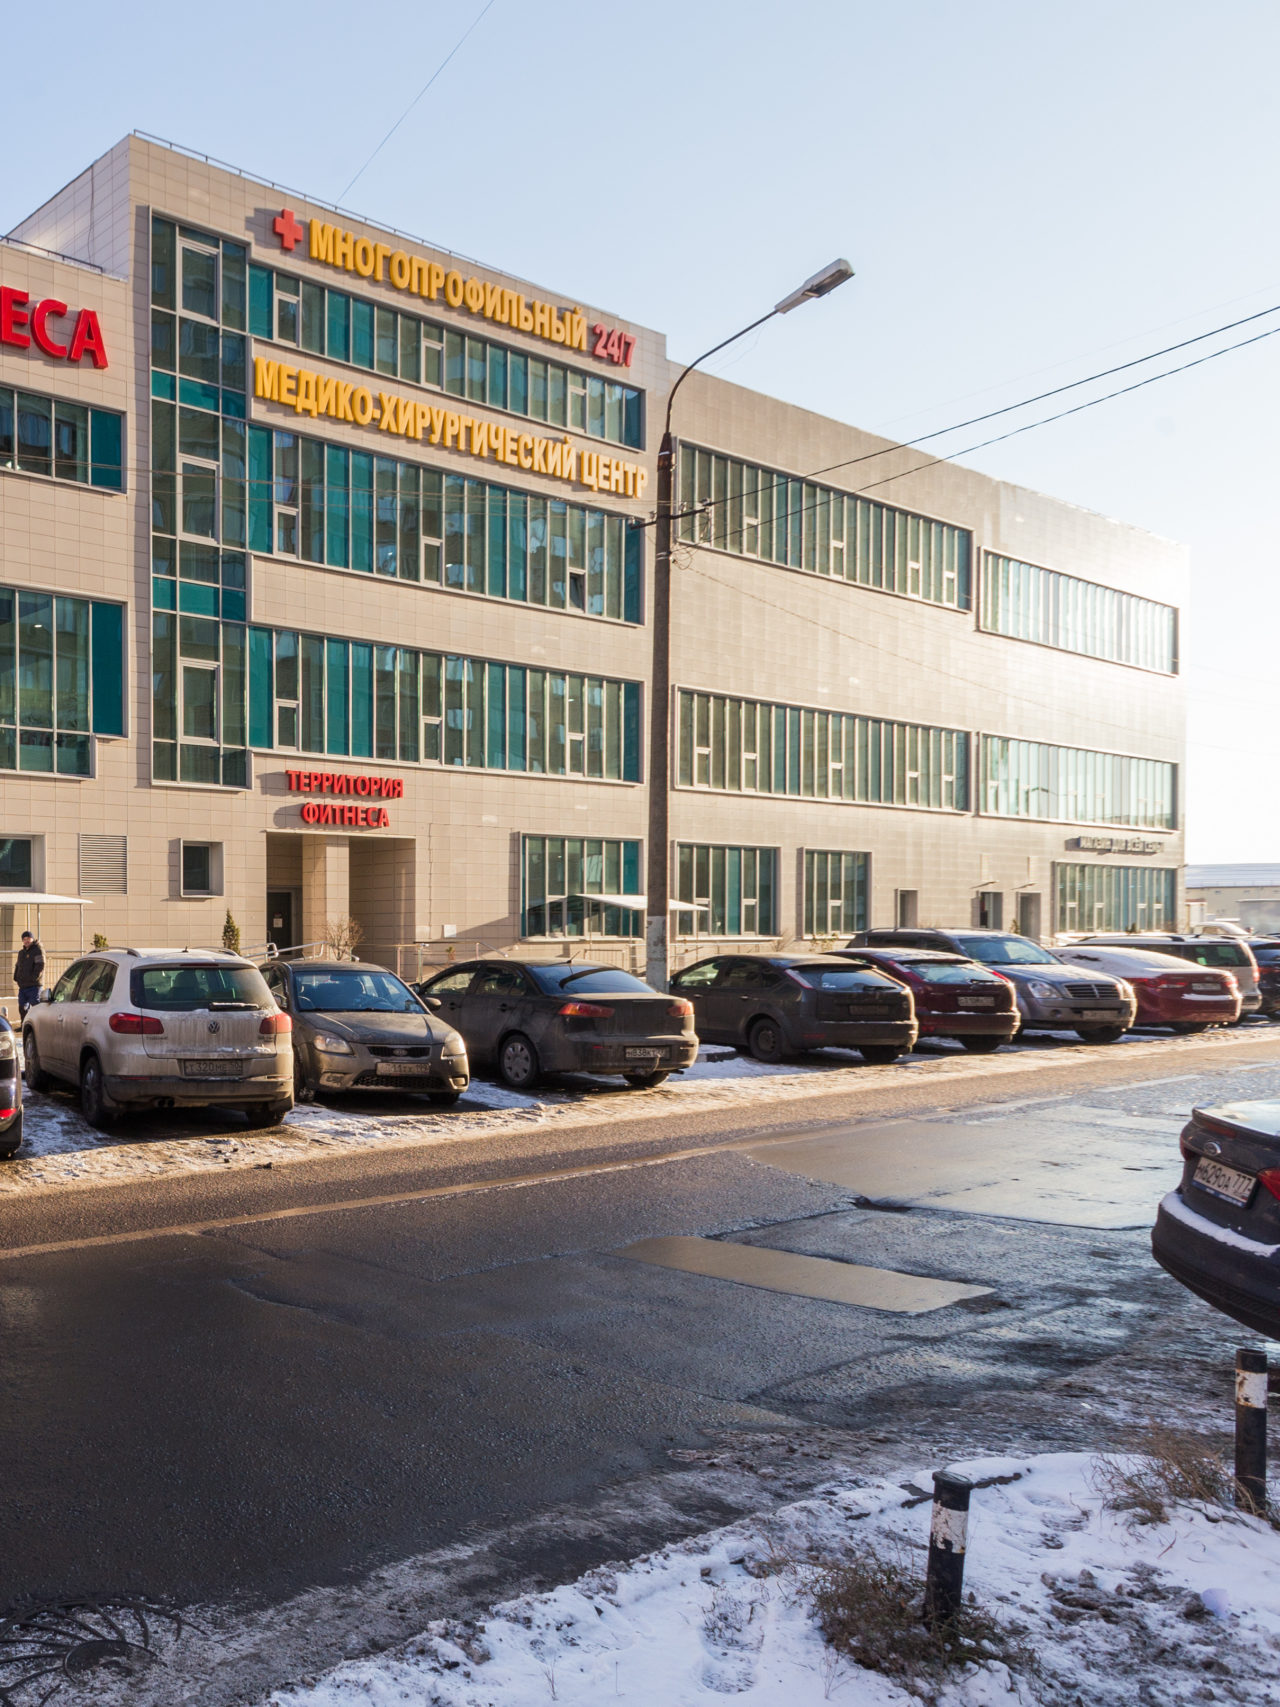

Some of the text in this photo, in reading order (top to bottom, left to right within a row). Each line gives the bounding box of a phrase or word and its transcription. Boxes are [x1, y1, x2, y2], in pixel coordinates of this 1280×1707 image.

[309, 218, 636, 368] МНОГОПРОФИЛЬНЫЙ 24/7
[254, 356, 649, 499] МЕДИКО-ХИРУРГИЧЕСКИЙ ЦЕНТР
[285, 769, 404, 799] ТЕРРИТОРИЯ
[301, 801, 390, 828] ФИТНЕСА
